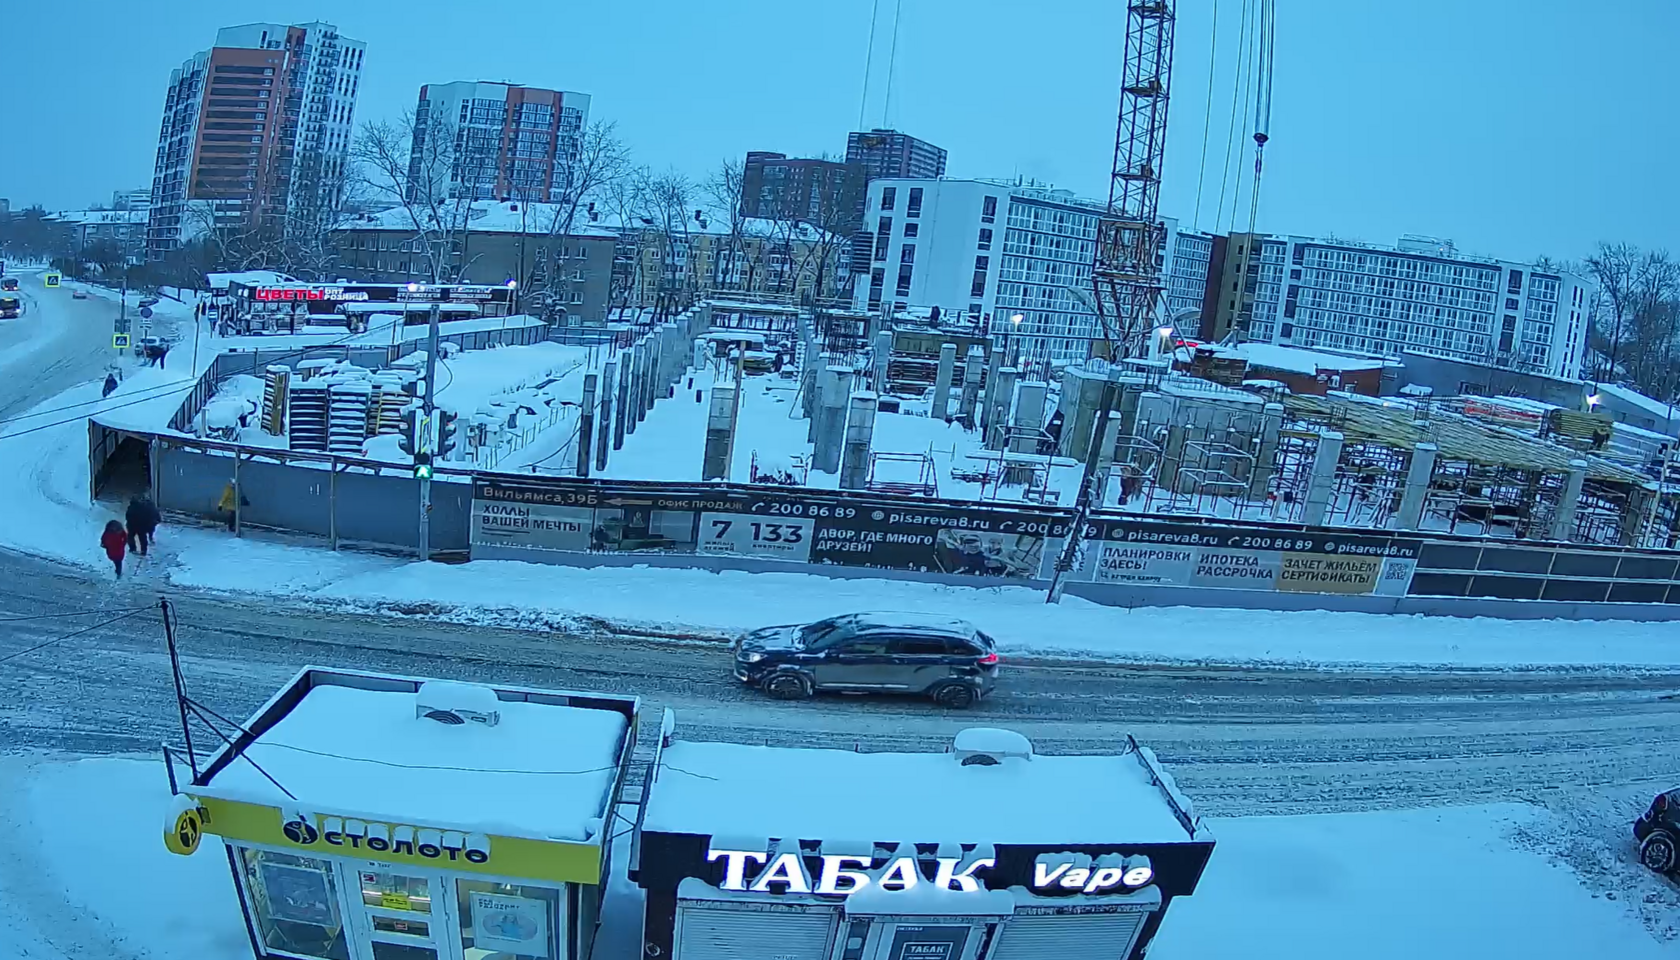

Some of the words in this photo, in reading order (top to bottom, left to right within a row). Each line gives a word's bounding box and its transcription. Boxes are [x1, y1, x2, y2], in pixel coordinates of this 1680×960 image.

[256, 287, 324, 301] ЦВЕТЫ
[483, 504, 530, 517] ХОЛЛЫ
[658, 499, 689, 507] ОФИС
[769, 502, 803, 514] 200
[808, 505, 829, 516] 86
[835, 507, 856, 518] 89
[482, 515, 529, 529] ВАШЕЙ
[533, 519, 581, 532] МЕЧТЫ
[889, 512, 990, 529] pisareva8.ru
[711, 520, 733, 539] 7
[750, 522, 803, 543] 133
[818, 528, 856, 541] ДВОР,
[860, 531, 884, 543] ГДЕ
[886, 533, 933, 545] МНОГО
[1128, 529, 1218, 545] pisareva8.ru
[816, 540, 872, 553] ДРУЗЕЙ!
[1242, 537, 1270, 547] 200
[1274, 538, 1292, 549] 86
[1295, 540, 1313, 550] 89
[1338, 542, 1413, 557] pisareva8.ru
[1103, 547, 1191, 562] ПЛАНИРОВКИ
[1200, 553, 1259, 567] ИПОТЕКА
[1101, 558, 1147, 571] ЗДЕСЬ!
[1284, 559, 1323, 570] ЗАЧЕТ
[1323, 560, 1377, 573] ЖИЛЬЁМ
[1197, 566, 1273, 580] РАССРОЧКА
[707, 850, 996, 895] ТАБАК
[1034, 862, 1152, 893] Vape
[910, 945, 945, 954] ТАБАК
